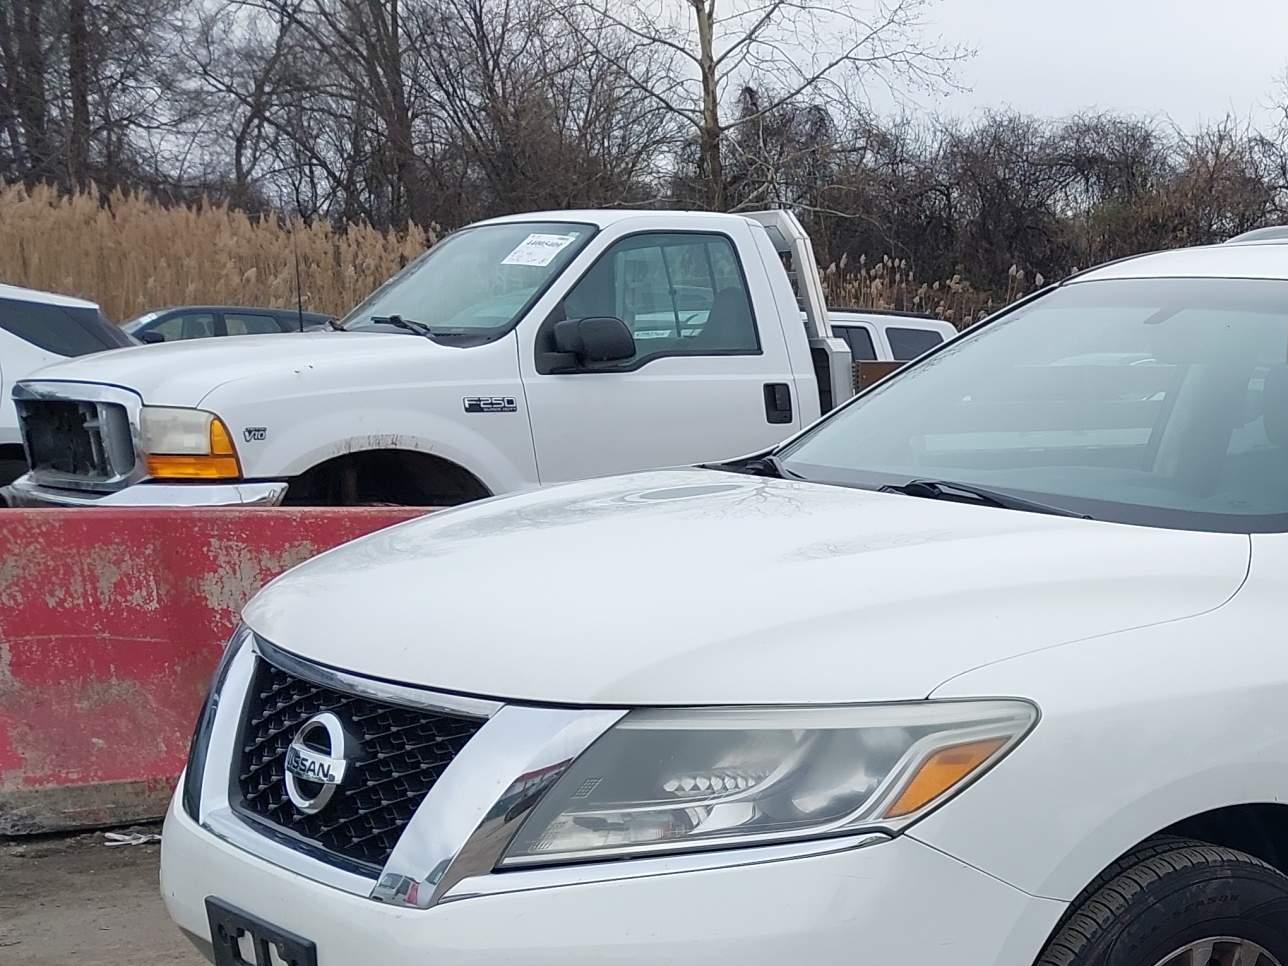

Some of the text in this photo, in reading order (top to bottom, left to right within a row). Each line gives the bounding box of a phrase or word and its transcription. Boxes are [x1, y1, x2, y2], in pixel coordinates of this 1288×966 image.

[464, 397, 517, 409] F-250
[243, 430, 266, 442] V10
[287, 748, 331, 779] NISSAN
